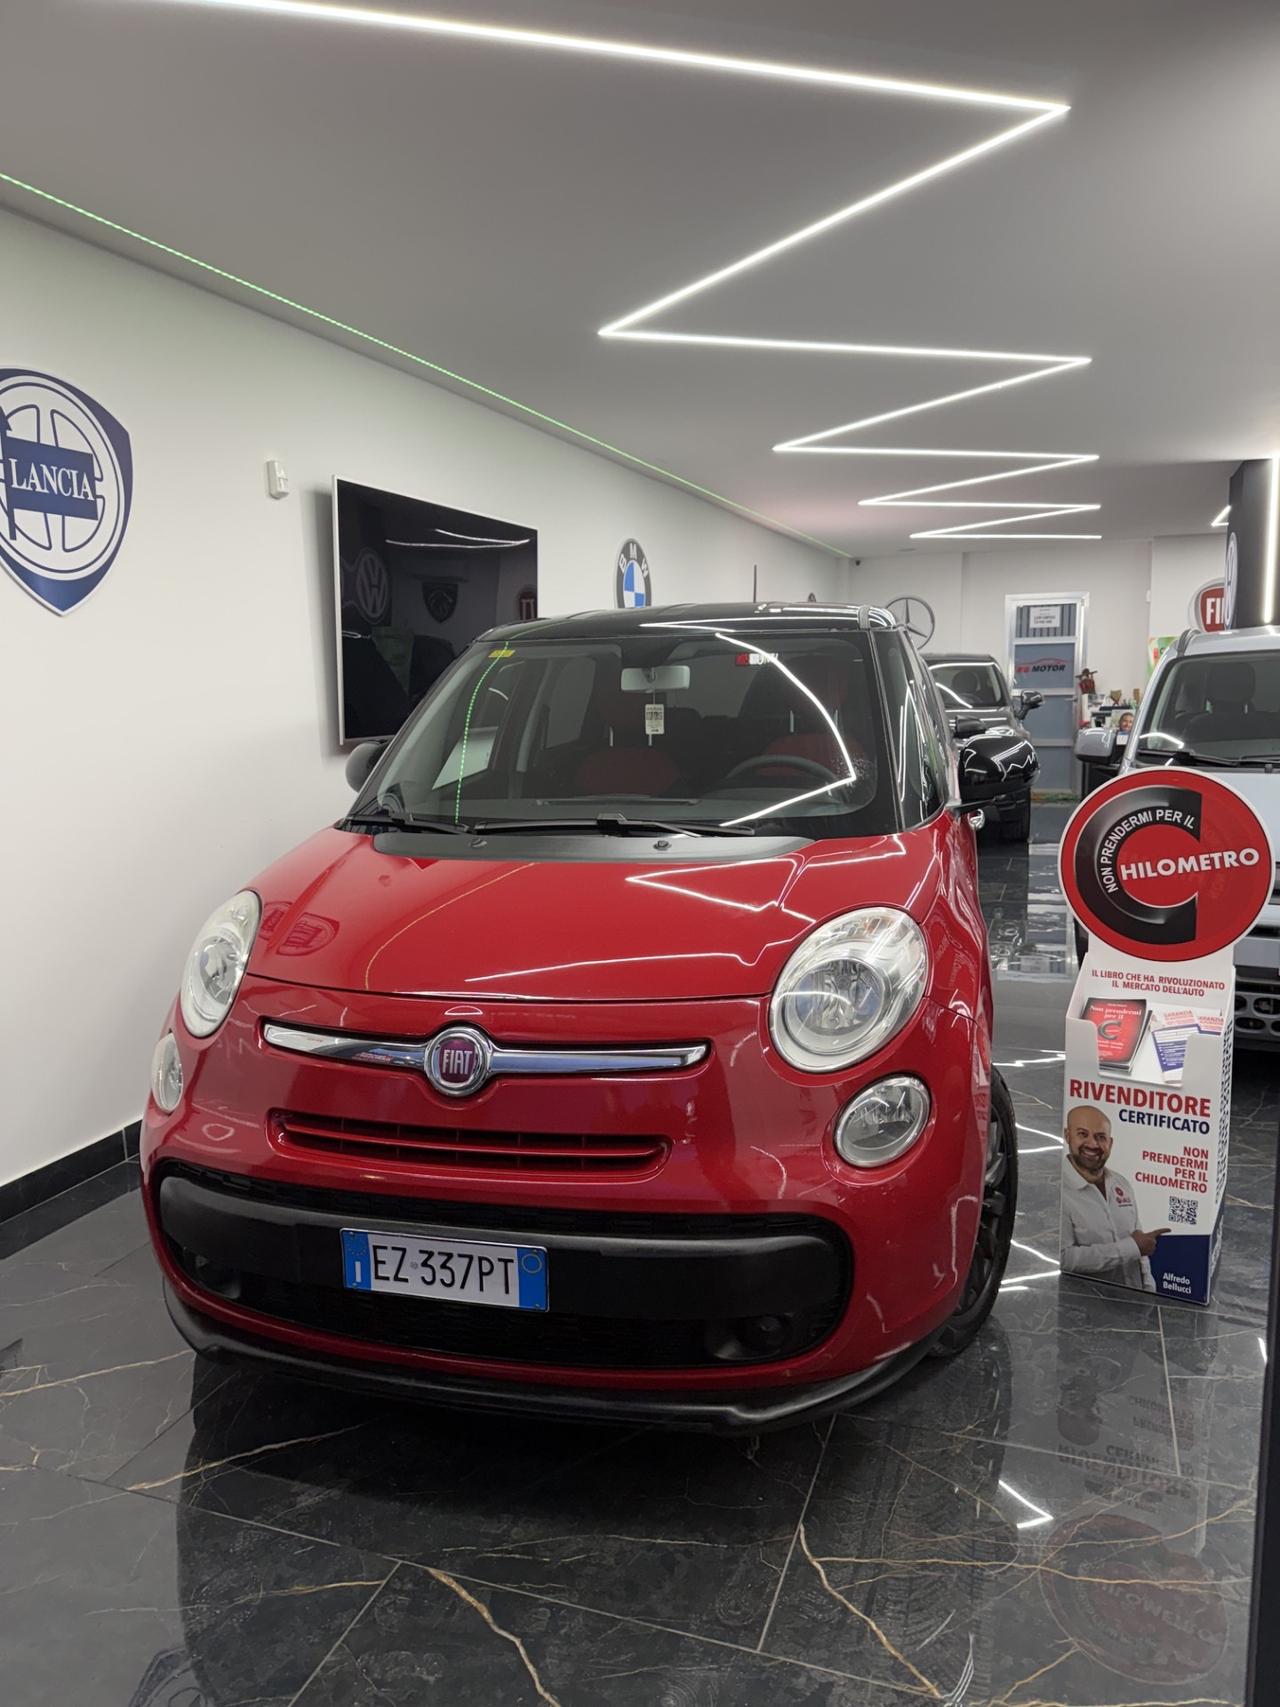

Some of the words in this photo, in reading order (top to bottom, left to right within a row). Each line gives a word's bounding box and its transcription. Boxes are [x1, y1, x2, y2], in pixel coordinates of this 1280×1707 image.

[8, 457, 95, 501] LANCIA
[1032, 665, 1066, 673] MOTOR
[1156, 809, 1182, 821] PER
[1184, 815, 1195, 829] IL
[1101, 811, 1153, 864] PRENDERMI
[1120, 848, 1260, 881] HILOMETRO
[1101, 867, 1119, 893] NON
[1092, 969, 1099, 977] IL
[1100, 970, 1124, 980] LIBRO
[1126, 972, 1141, 981] CHE
[1143, 974, 1155, 982] HA
[1158, 976, 1225, 990] RIVOLUZIONATO
[1112, 980, 1119, 988] IL
[1122, 981, 1160, 992] MERCATO
[1162, 983, 1205, 997] DELL'AUTO
[442, 1049, 473, 1075] FIAT
[1069, 1079, 1211, 1118] RIVENDITORE
[1119, 1108, 1210, 1135] CERTIFICATO
[1142, 1150, 1208, 1171] PRENDERMI
[1183, 1146, 1209, 1160] NON
[1135, 1171, 1208, 1194] CHILOMETRO
[1174, 1167, 1195, 1181] PER
[1198, 1172, 1208, 1183] IL
[1163, 1272, 1190, 1285] Alfredo
[1163, 1281, 1192, 1294] Bellucci
